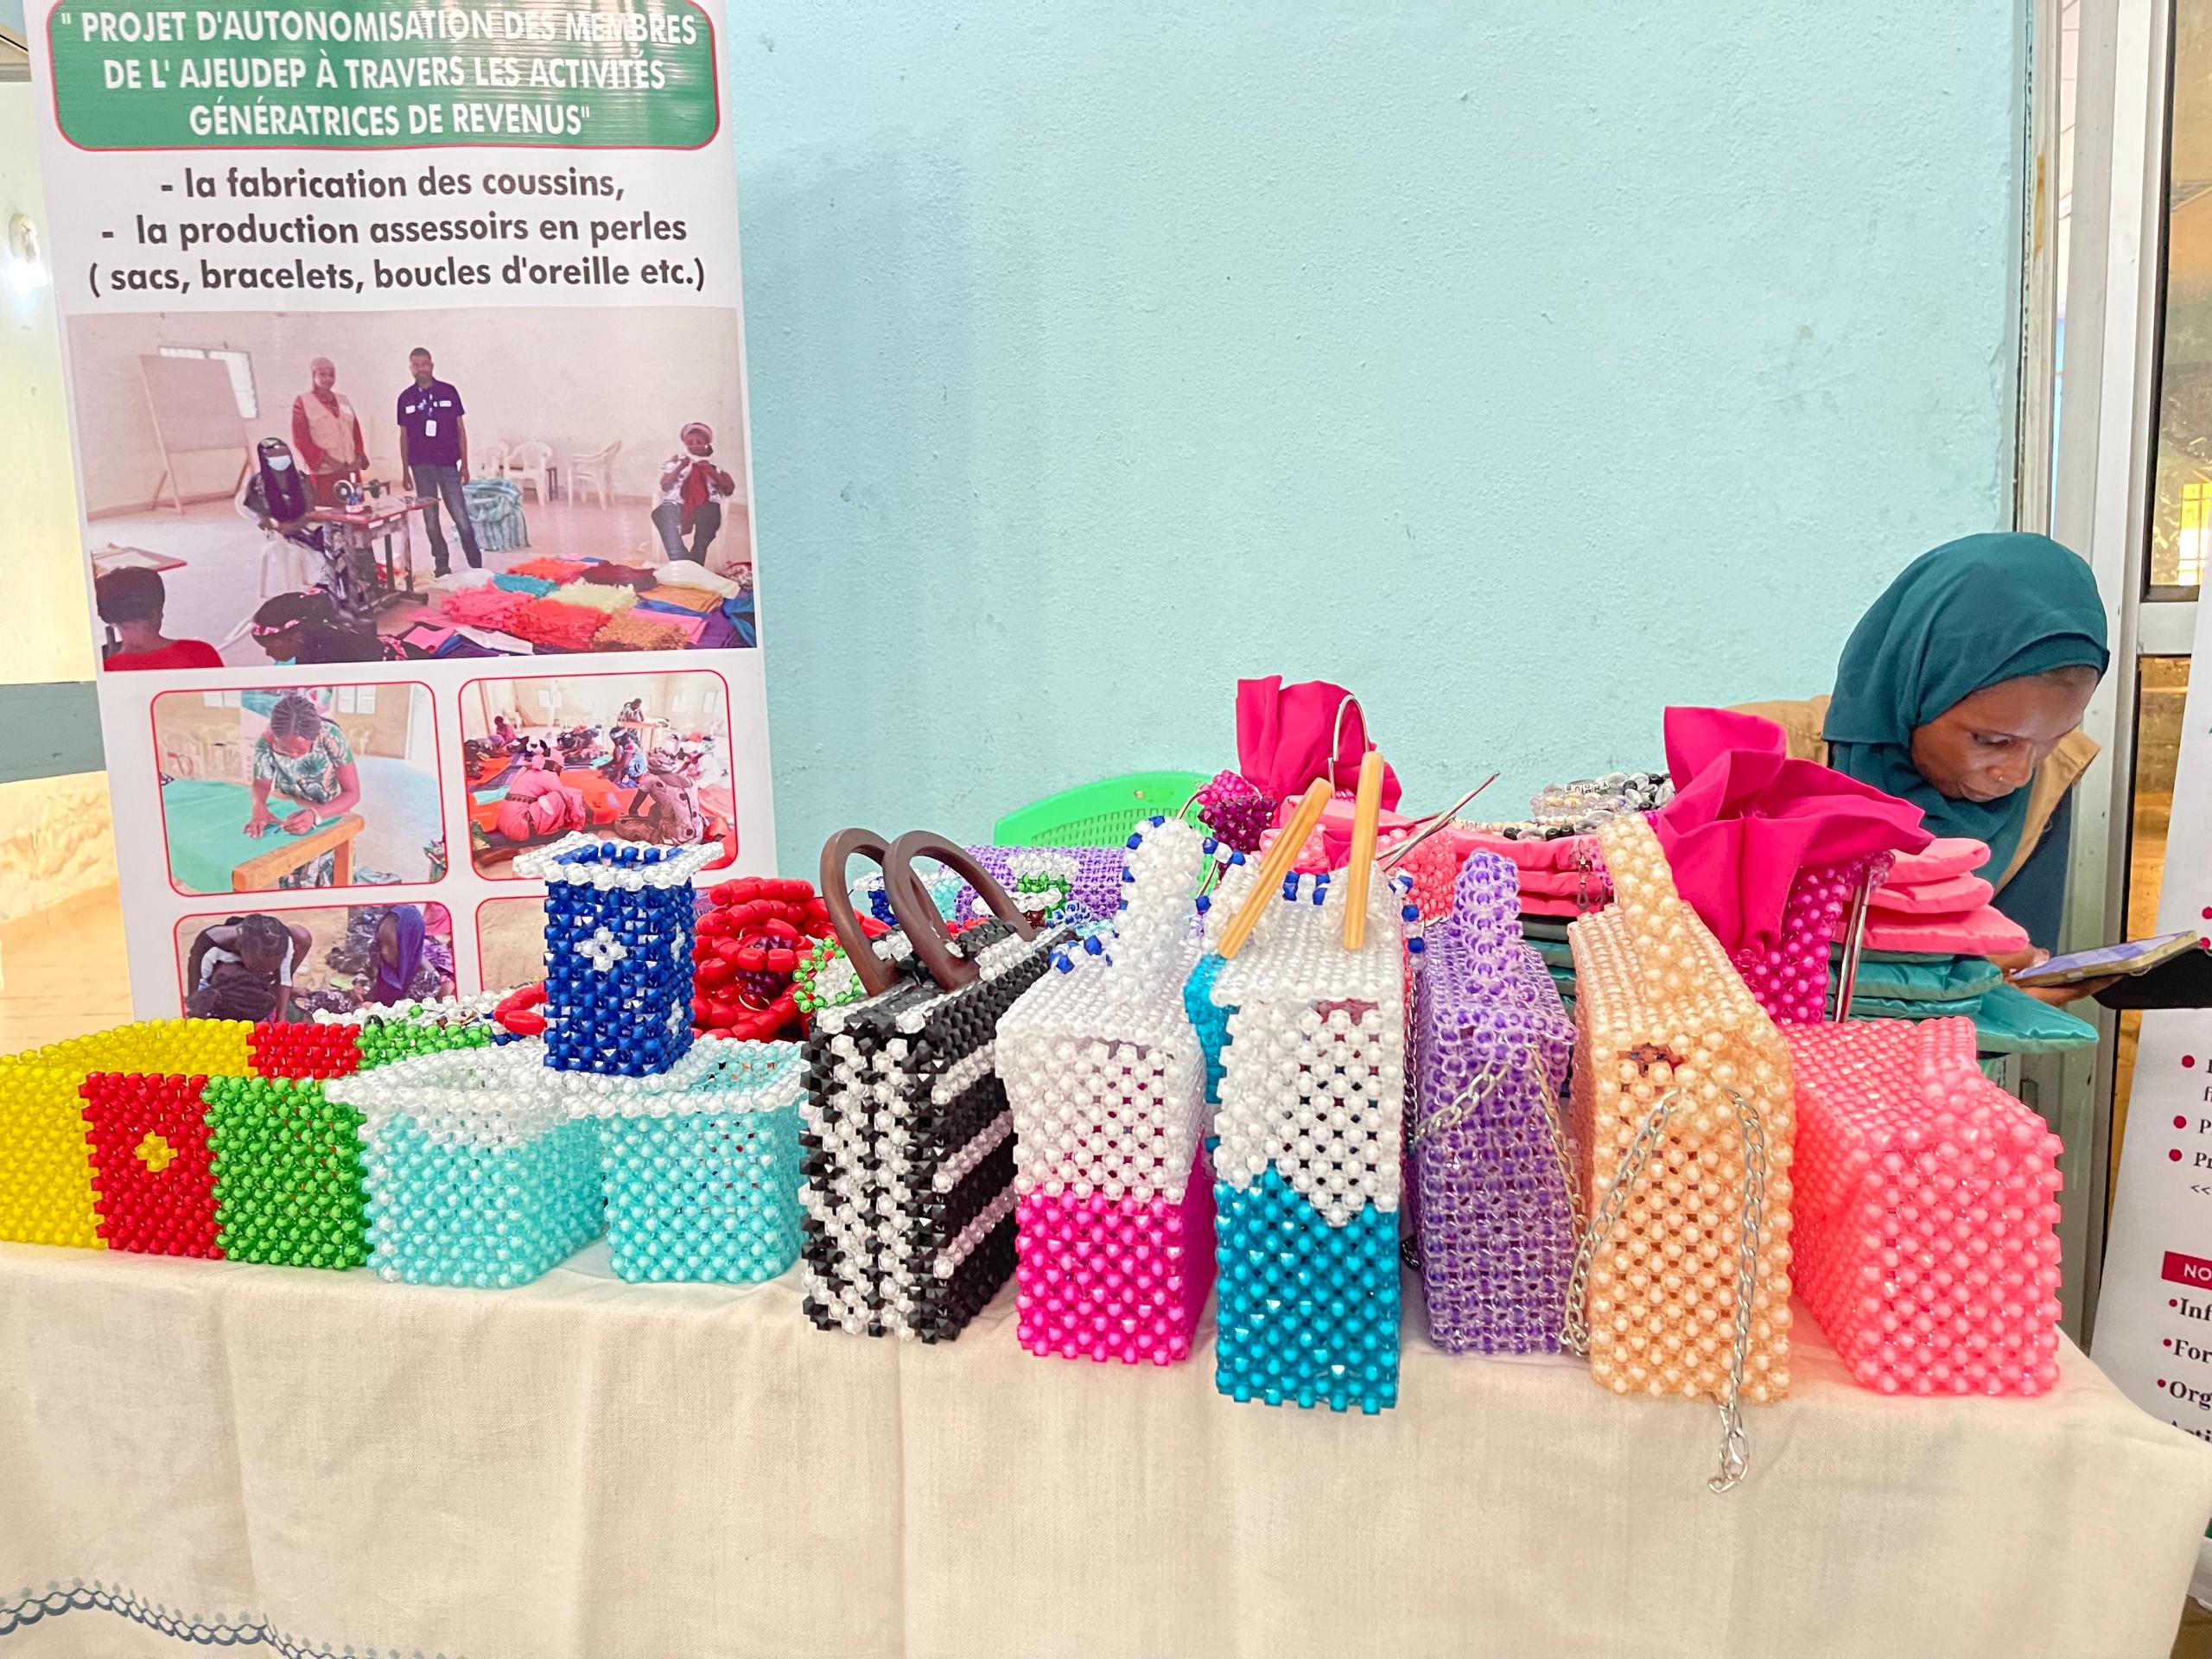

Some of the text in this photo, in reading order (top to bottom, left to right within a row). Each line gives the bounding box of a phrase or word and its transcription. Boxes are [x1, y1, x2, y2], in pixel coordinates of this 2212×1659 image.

[82, 11, 187, 41] PROJET
[196, 10, 493, 42] D'AUTONOMISATION
[505, 11, 556, 41] DES
[565, 12, 697, 44] MEMBRES
[104, 48, 666, 90] DE L' AJEUDEP À TRAVERS LES ACTIVITÉS
[189, 95, 591, 137] GÉNÉRATRICES DE REVENUS"
[185, 167, 216, 198] la
[226, 167, 407, 198] fabrication
[418, 165, 473, 197] des
[482, 166, 625, 201] coussins,
[136, 214, 168, 245] la
[180, 213, 359, 251] production
[370, 210, 529, 244] assessoirs
[539, 219, 579, 241] en
[590, 210, 687, 249] perles
[111, 268, 190, 295] sacs,
[200, 258, 364, 295] bracelets,
[374, 257, 492, 289] boucles
[502, 255, 630, 285] d'oreille
[640, 257, 705, 292] etc.)
